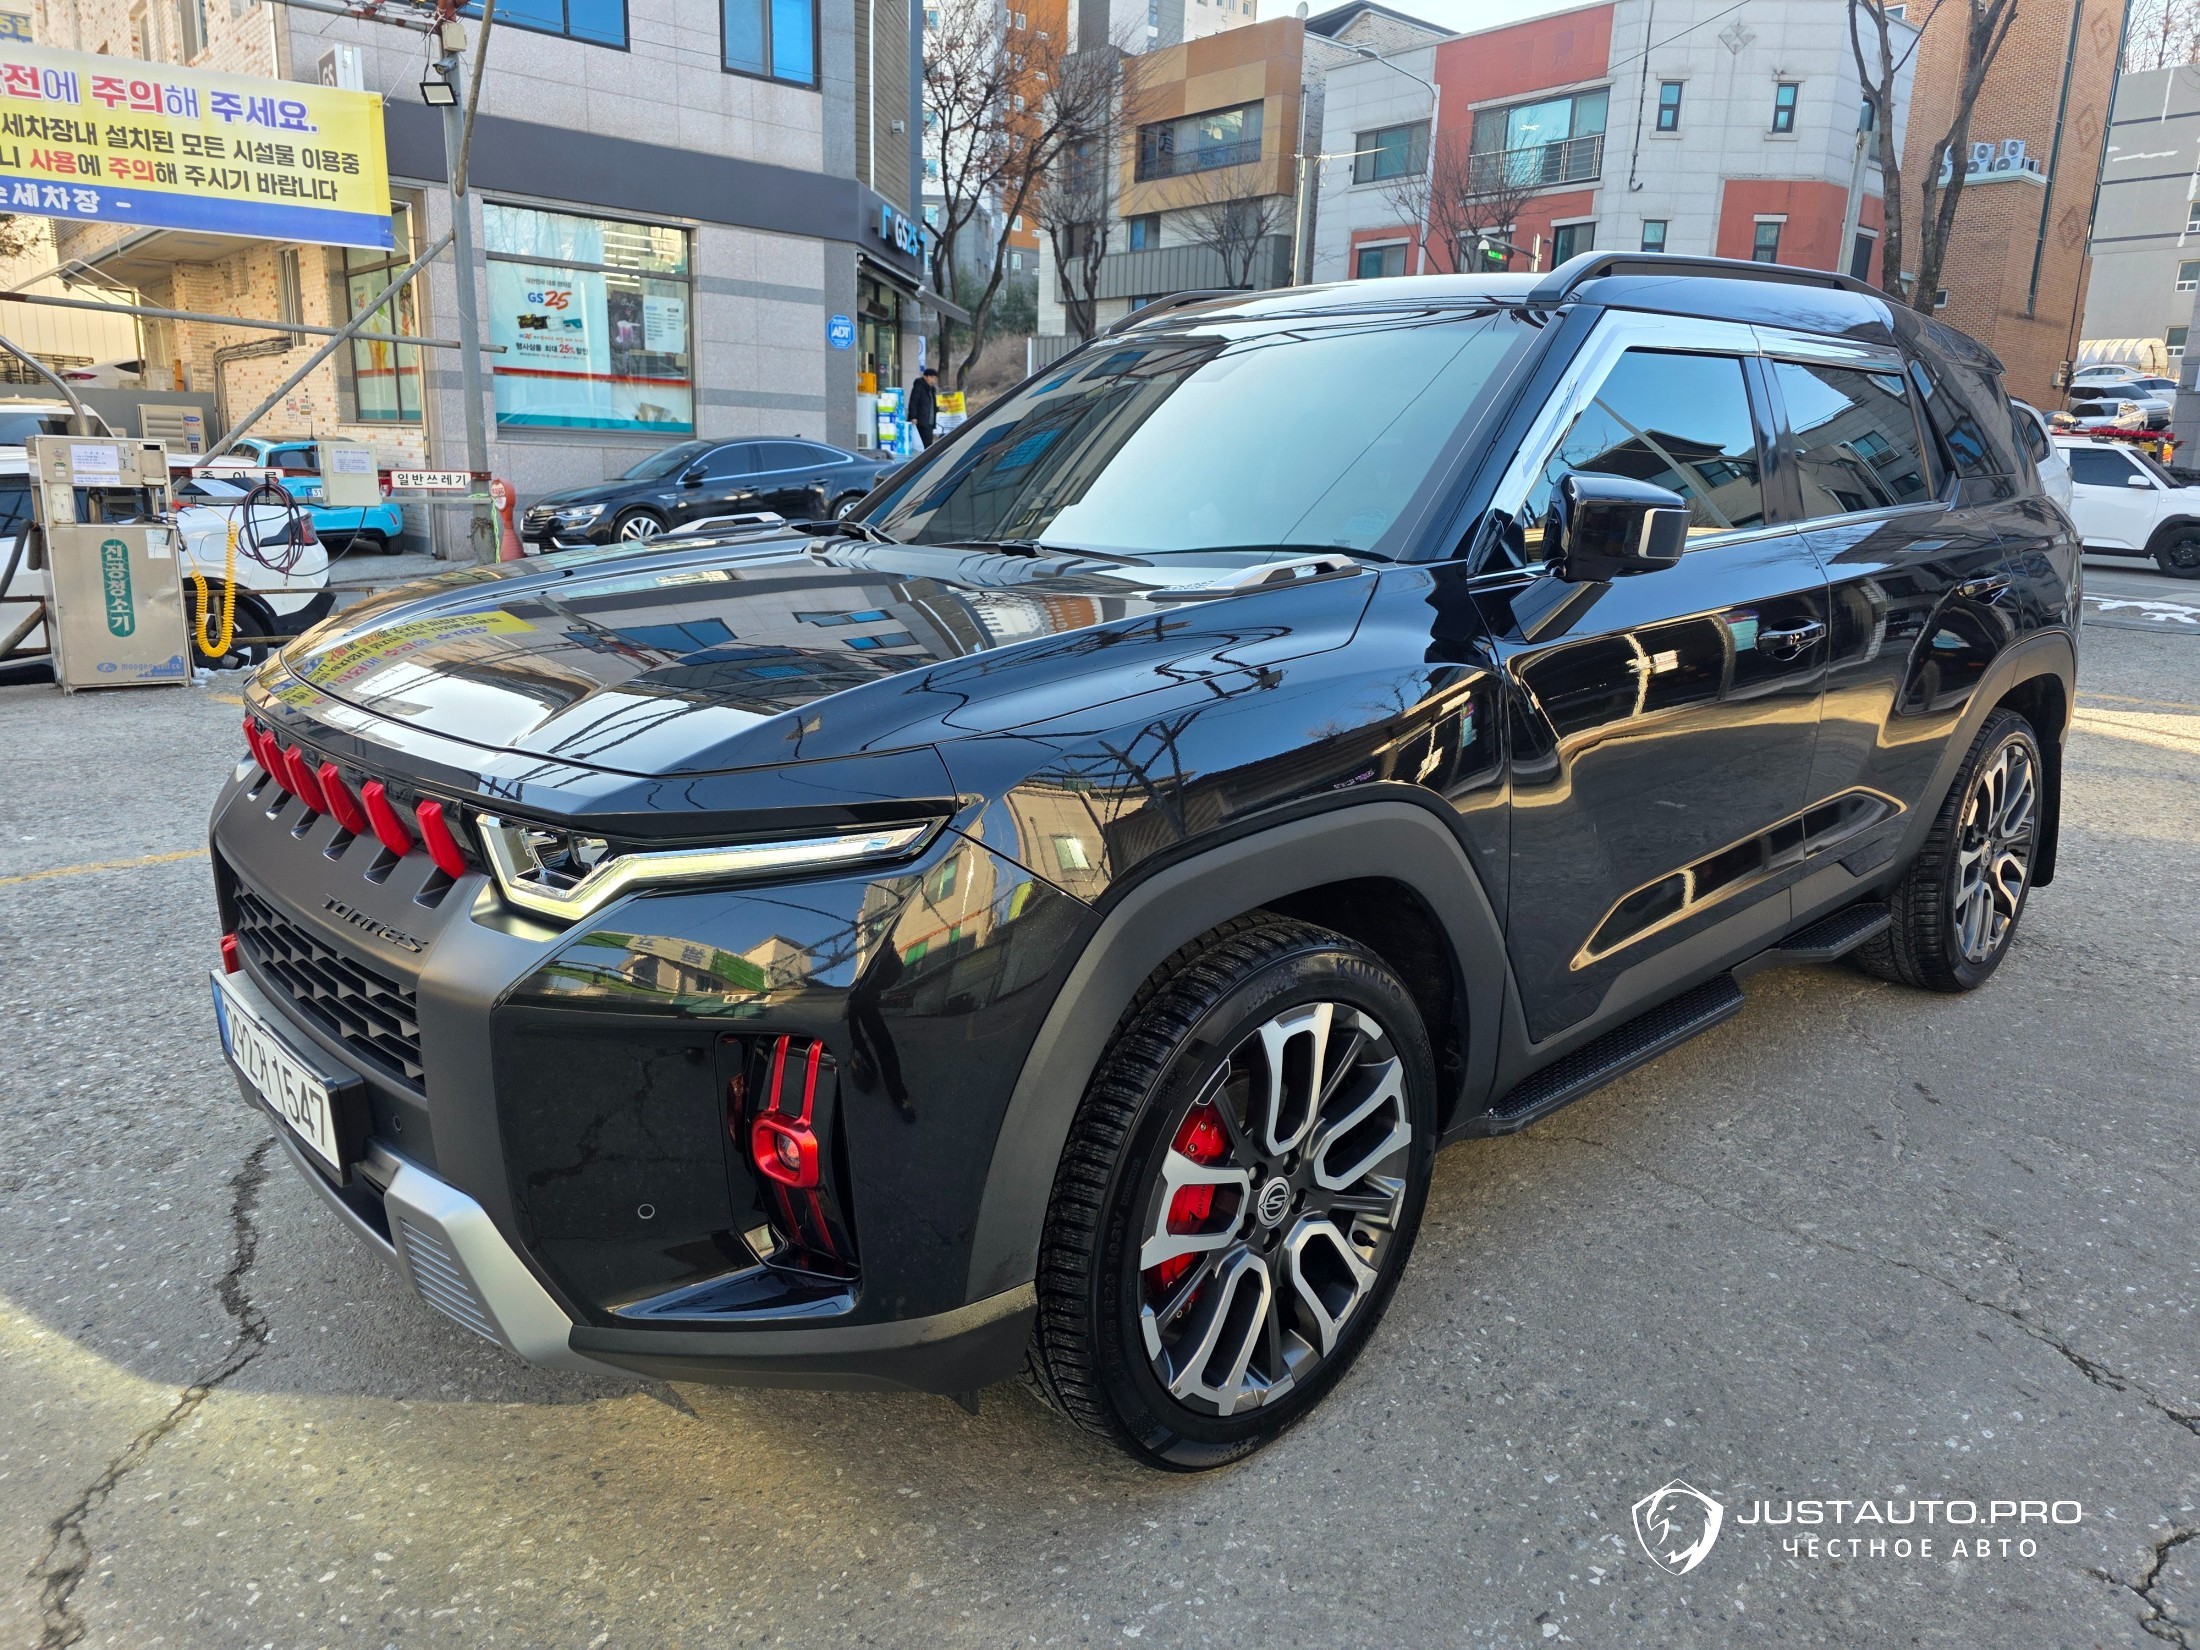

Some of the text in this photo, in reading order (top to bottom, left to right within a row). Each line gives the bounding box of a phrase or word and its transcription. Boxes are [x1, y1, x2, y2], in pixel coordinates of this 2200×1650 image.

[0, 63, 318, 133] 전에 주의해 주세요.
[2, 113, 360, 175] 세차장내 설치된 모든 시설물 이용중
[30, 148, 102, 177] 사용에
[108, 156, 178, 185] 주의해
[185, 164, 250, 193] 주시기
[256, 172, 338, 202] 바랍니다
[0, 182, 101, 214] 세차장
[895, 213, 918, 257] GS25
[527, 290, 573, 311] GS25
[831, 325, 851, 339] ADT
[397, 473, 467, 486] 일반쓰레기
[103, 544, 131, 632] 진공청소기
[1335, 957, 1401, 1001] KUMHO
